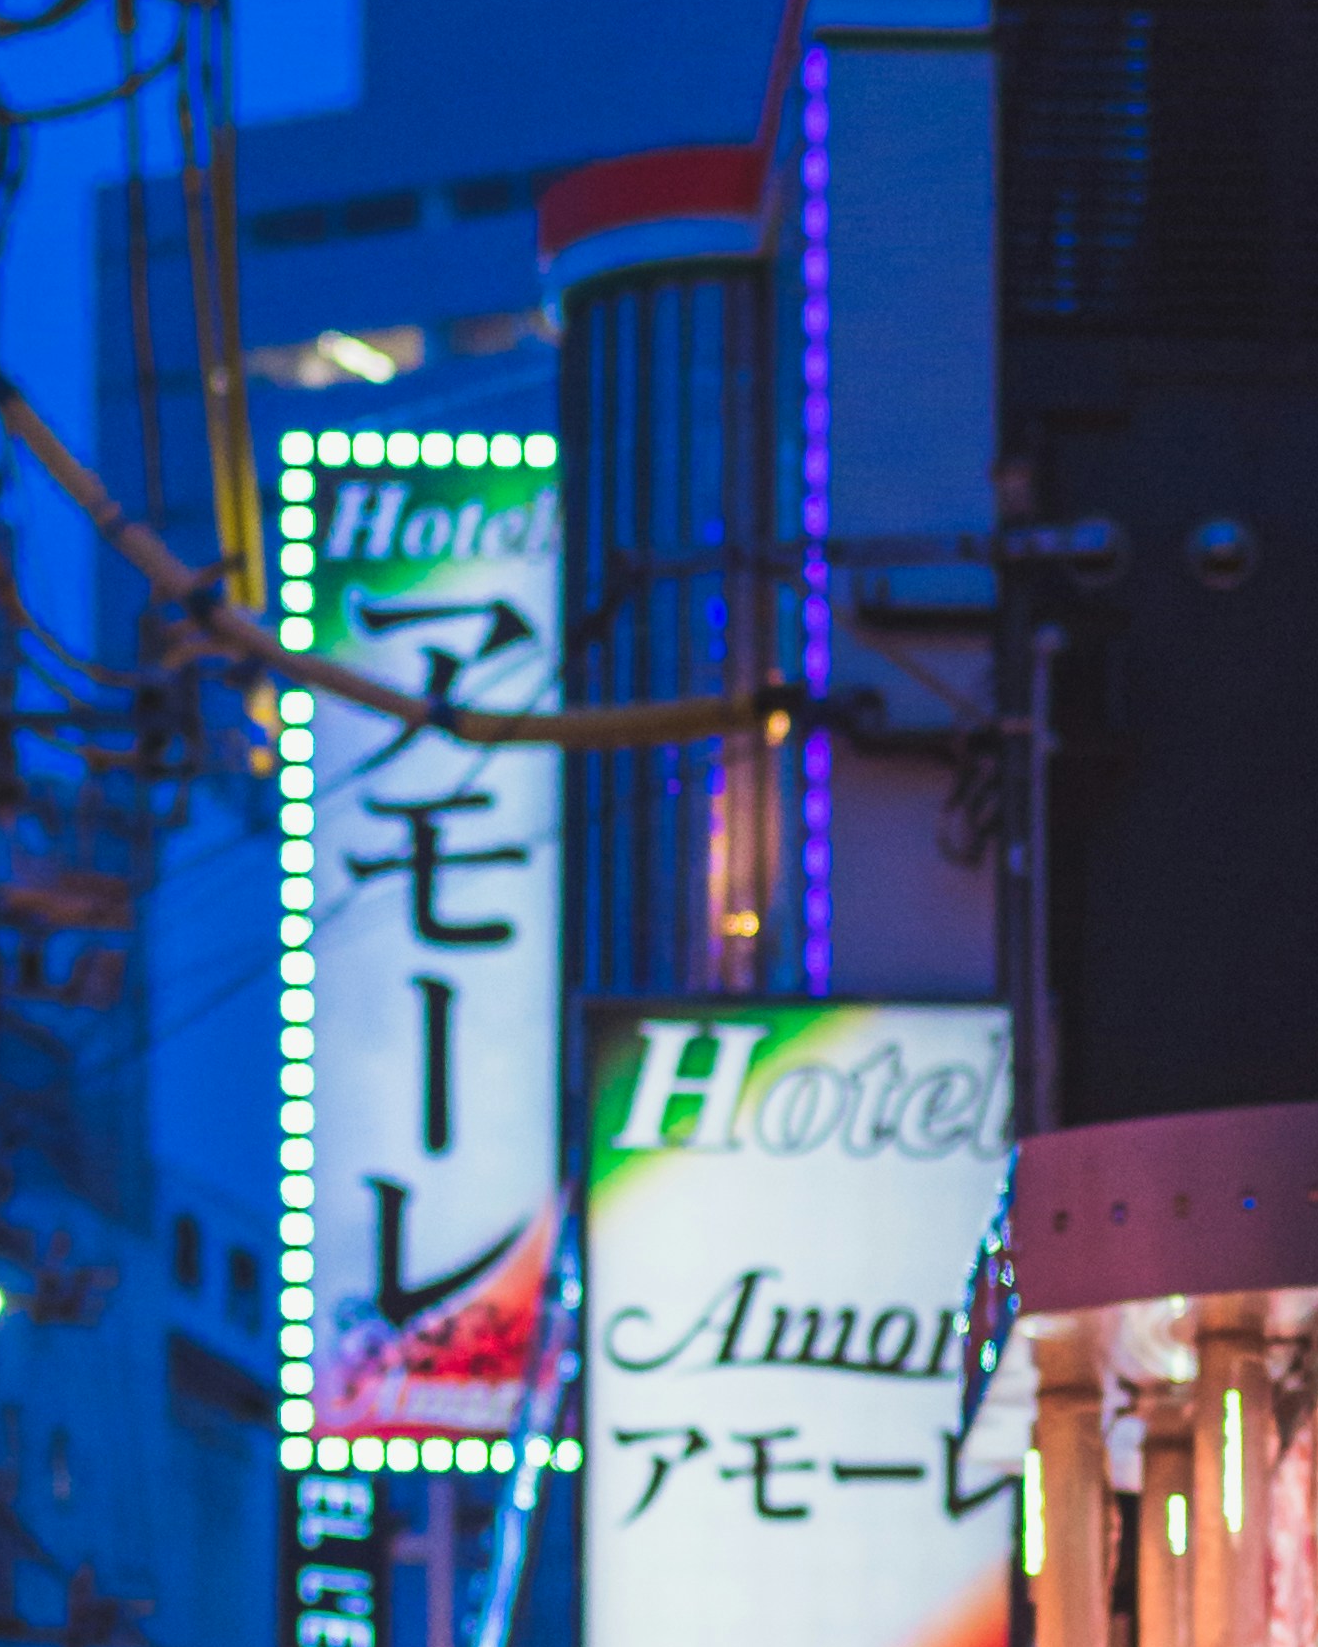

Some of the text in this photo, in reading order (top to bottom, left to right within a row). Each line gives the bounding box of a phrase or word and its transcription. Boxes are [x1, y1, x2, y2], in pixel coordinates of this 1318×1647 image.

[326, 480, 559, 560] Hotel
[343, 594, 535, 1327] アモーレ
[611, 1018, 1015, 1161] Hotel
[613, 1424, 1025, 1528] アモーレ
